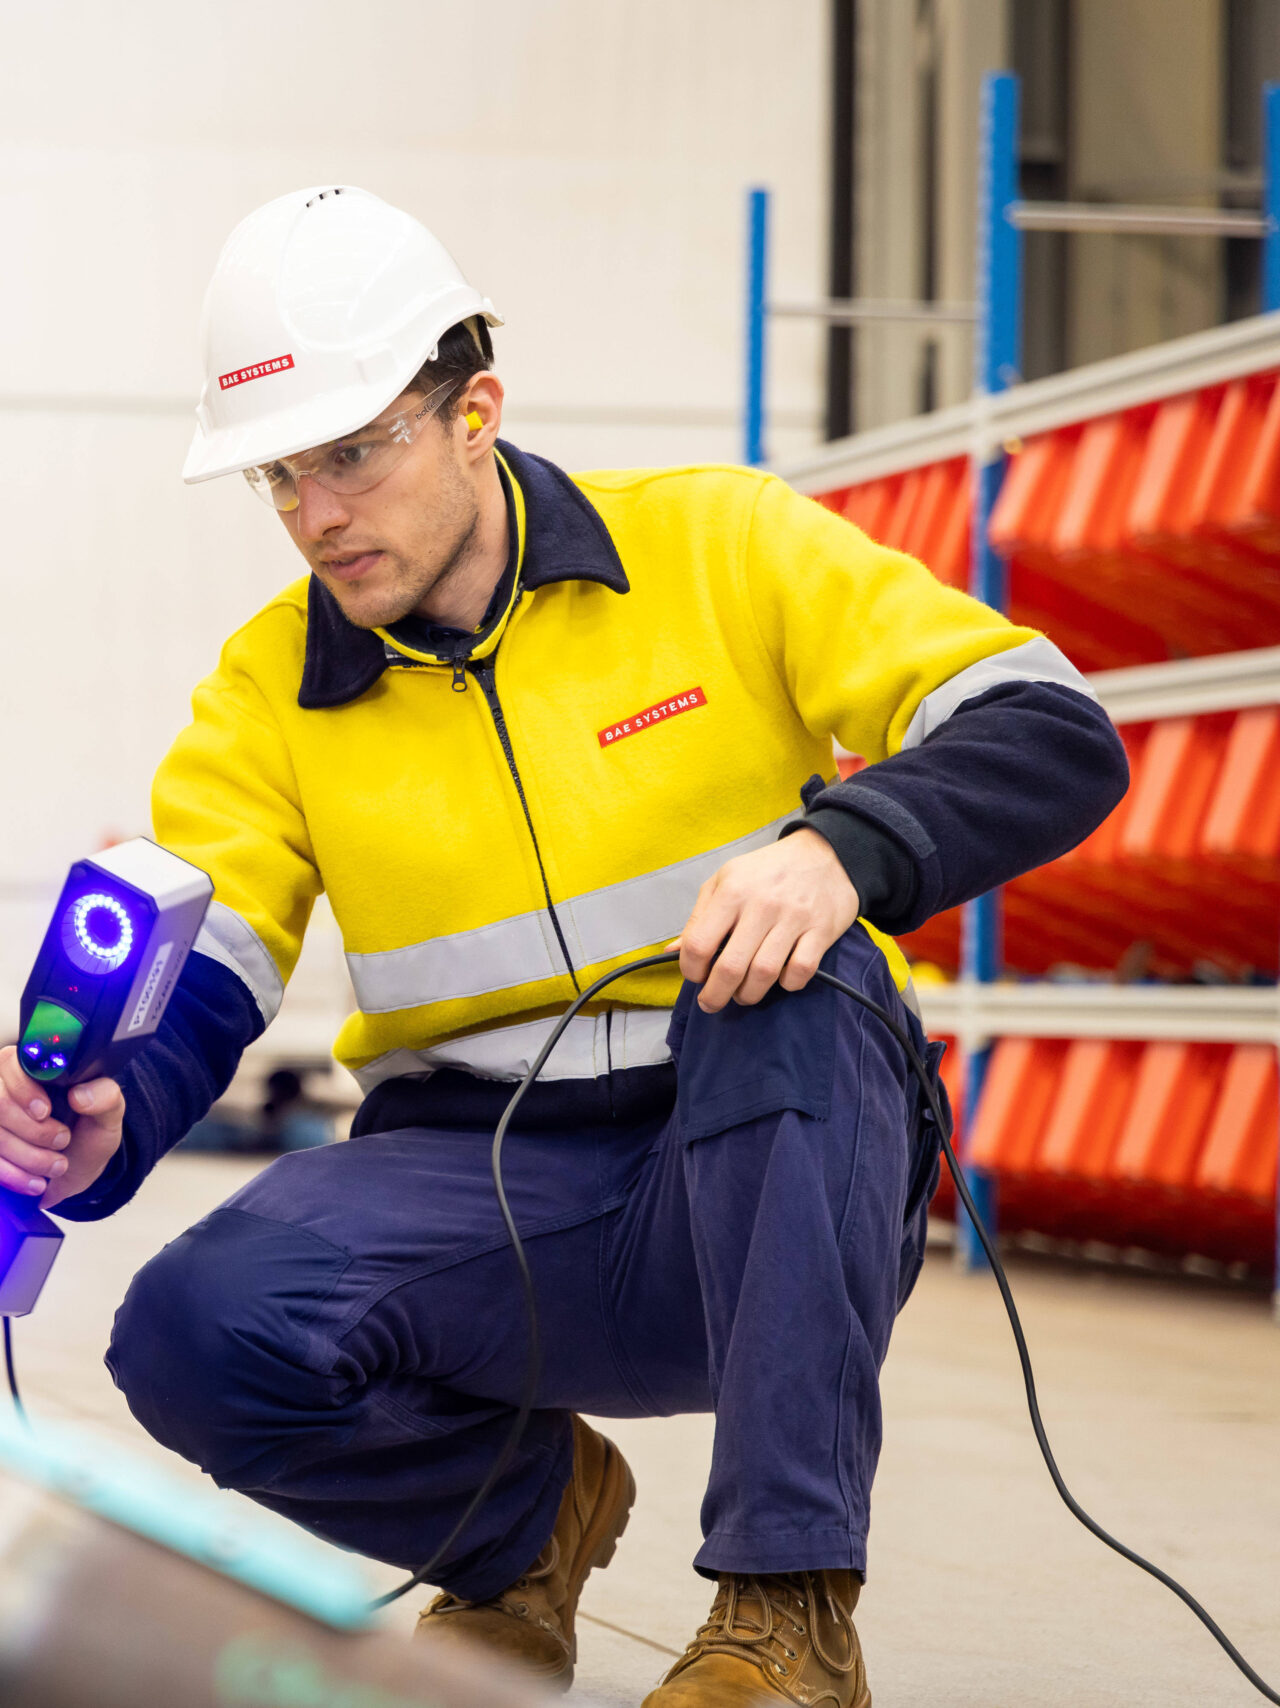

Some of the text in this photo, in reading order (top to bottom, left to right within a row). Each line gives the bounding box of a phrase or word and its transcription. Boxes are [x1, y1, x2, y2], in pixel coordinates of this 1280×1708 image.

[222, 358, 290, 387] BAE SYSTEMS
[605, 694, 698, 741] BAE SYSTEMS
